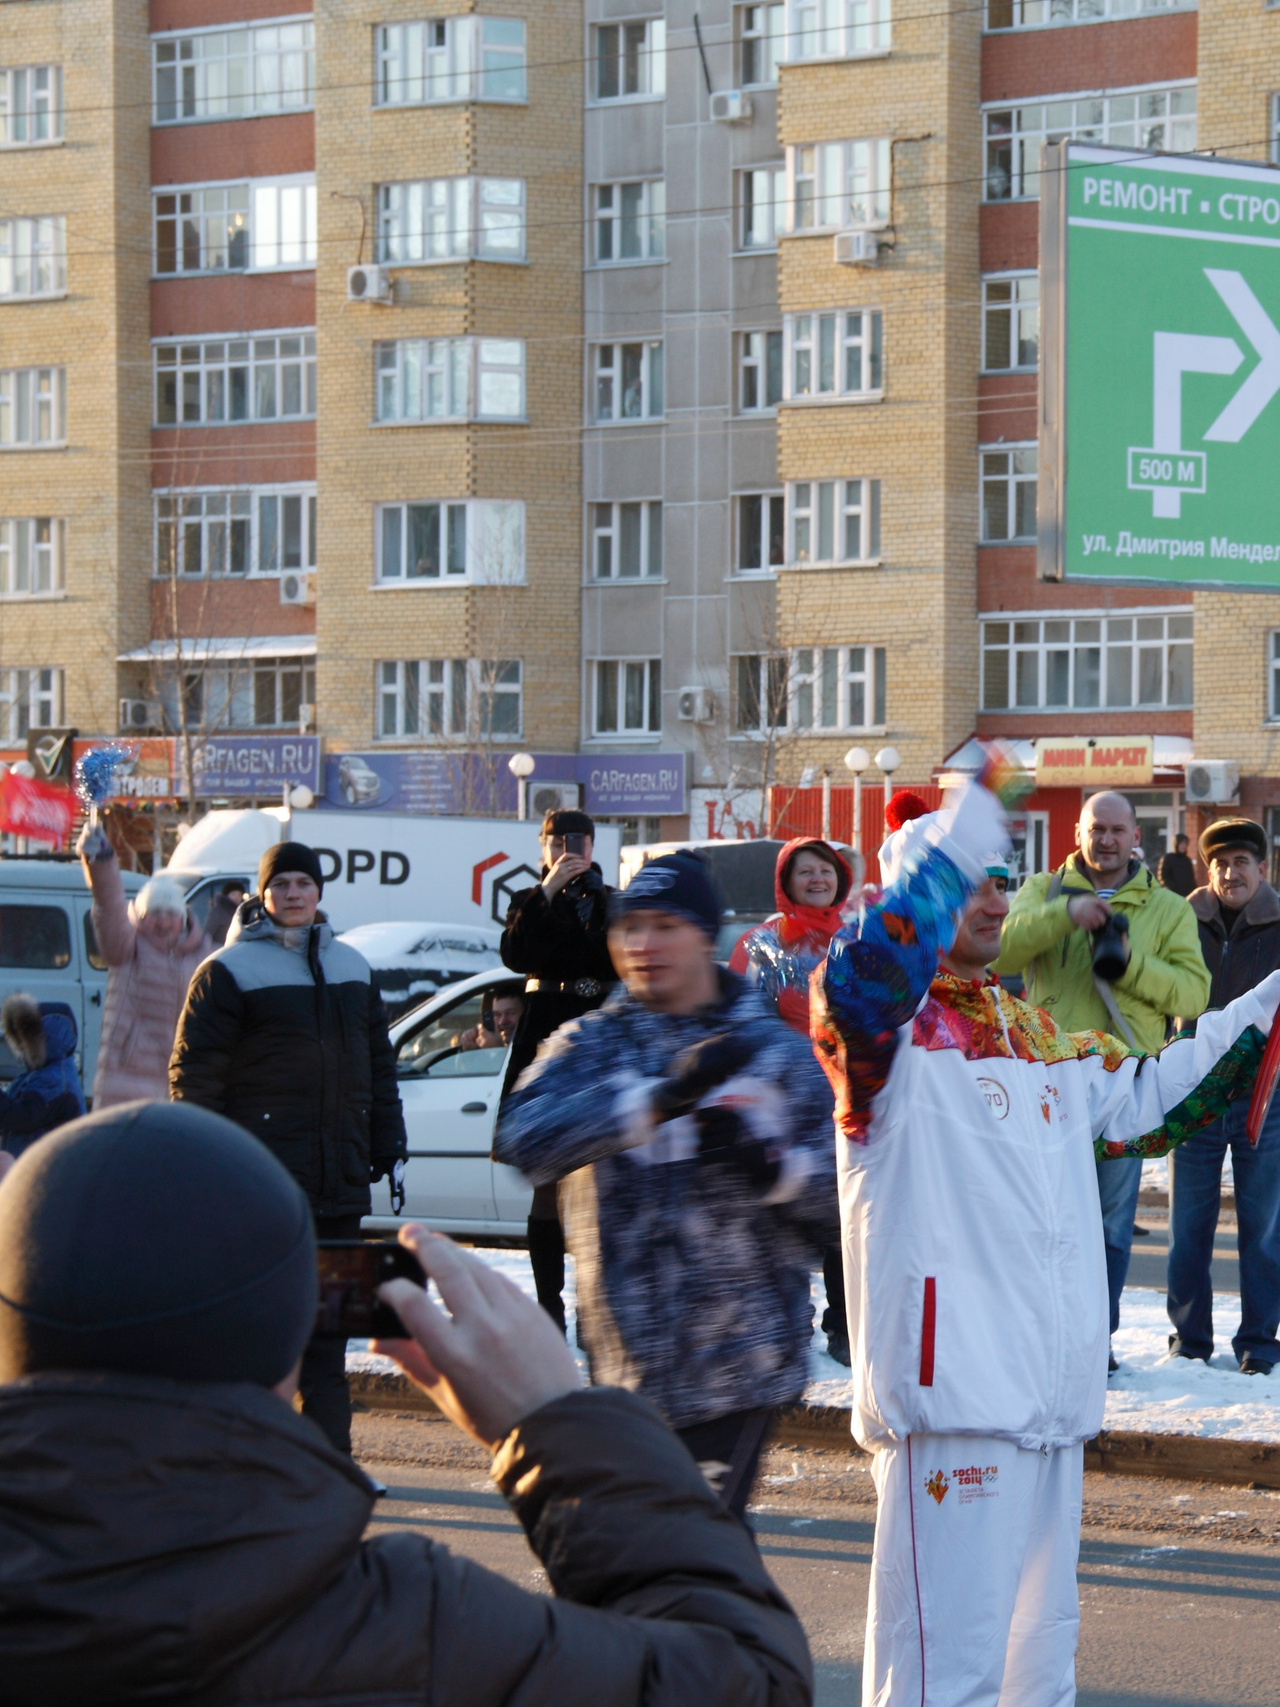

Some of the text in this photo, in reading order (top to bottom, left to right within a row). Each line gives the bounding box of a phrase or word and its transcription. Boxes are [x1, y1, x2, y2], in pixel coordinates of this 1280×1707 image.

[1083, 177, 1192, 215] РЕМОНТ
[1139, 458, 1173, 481] 500
[1082, 533, 1112, 555] ул.
[1115, 531, 1205, 560] Дмитрия
[191, 744, 313, 775] ARFAGEN.RU
[1091, 746, 1147, 767] МАРКЕТ
[312, 848, 410, 885] DPD
[984, 1093, 1003, 1106] 70
[952, 1465, 998, 1478] sochi.ru
[958, 1476, 982, 1486] 2014
